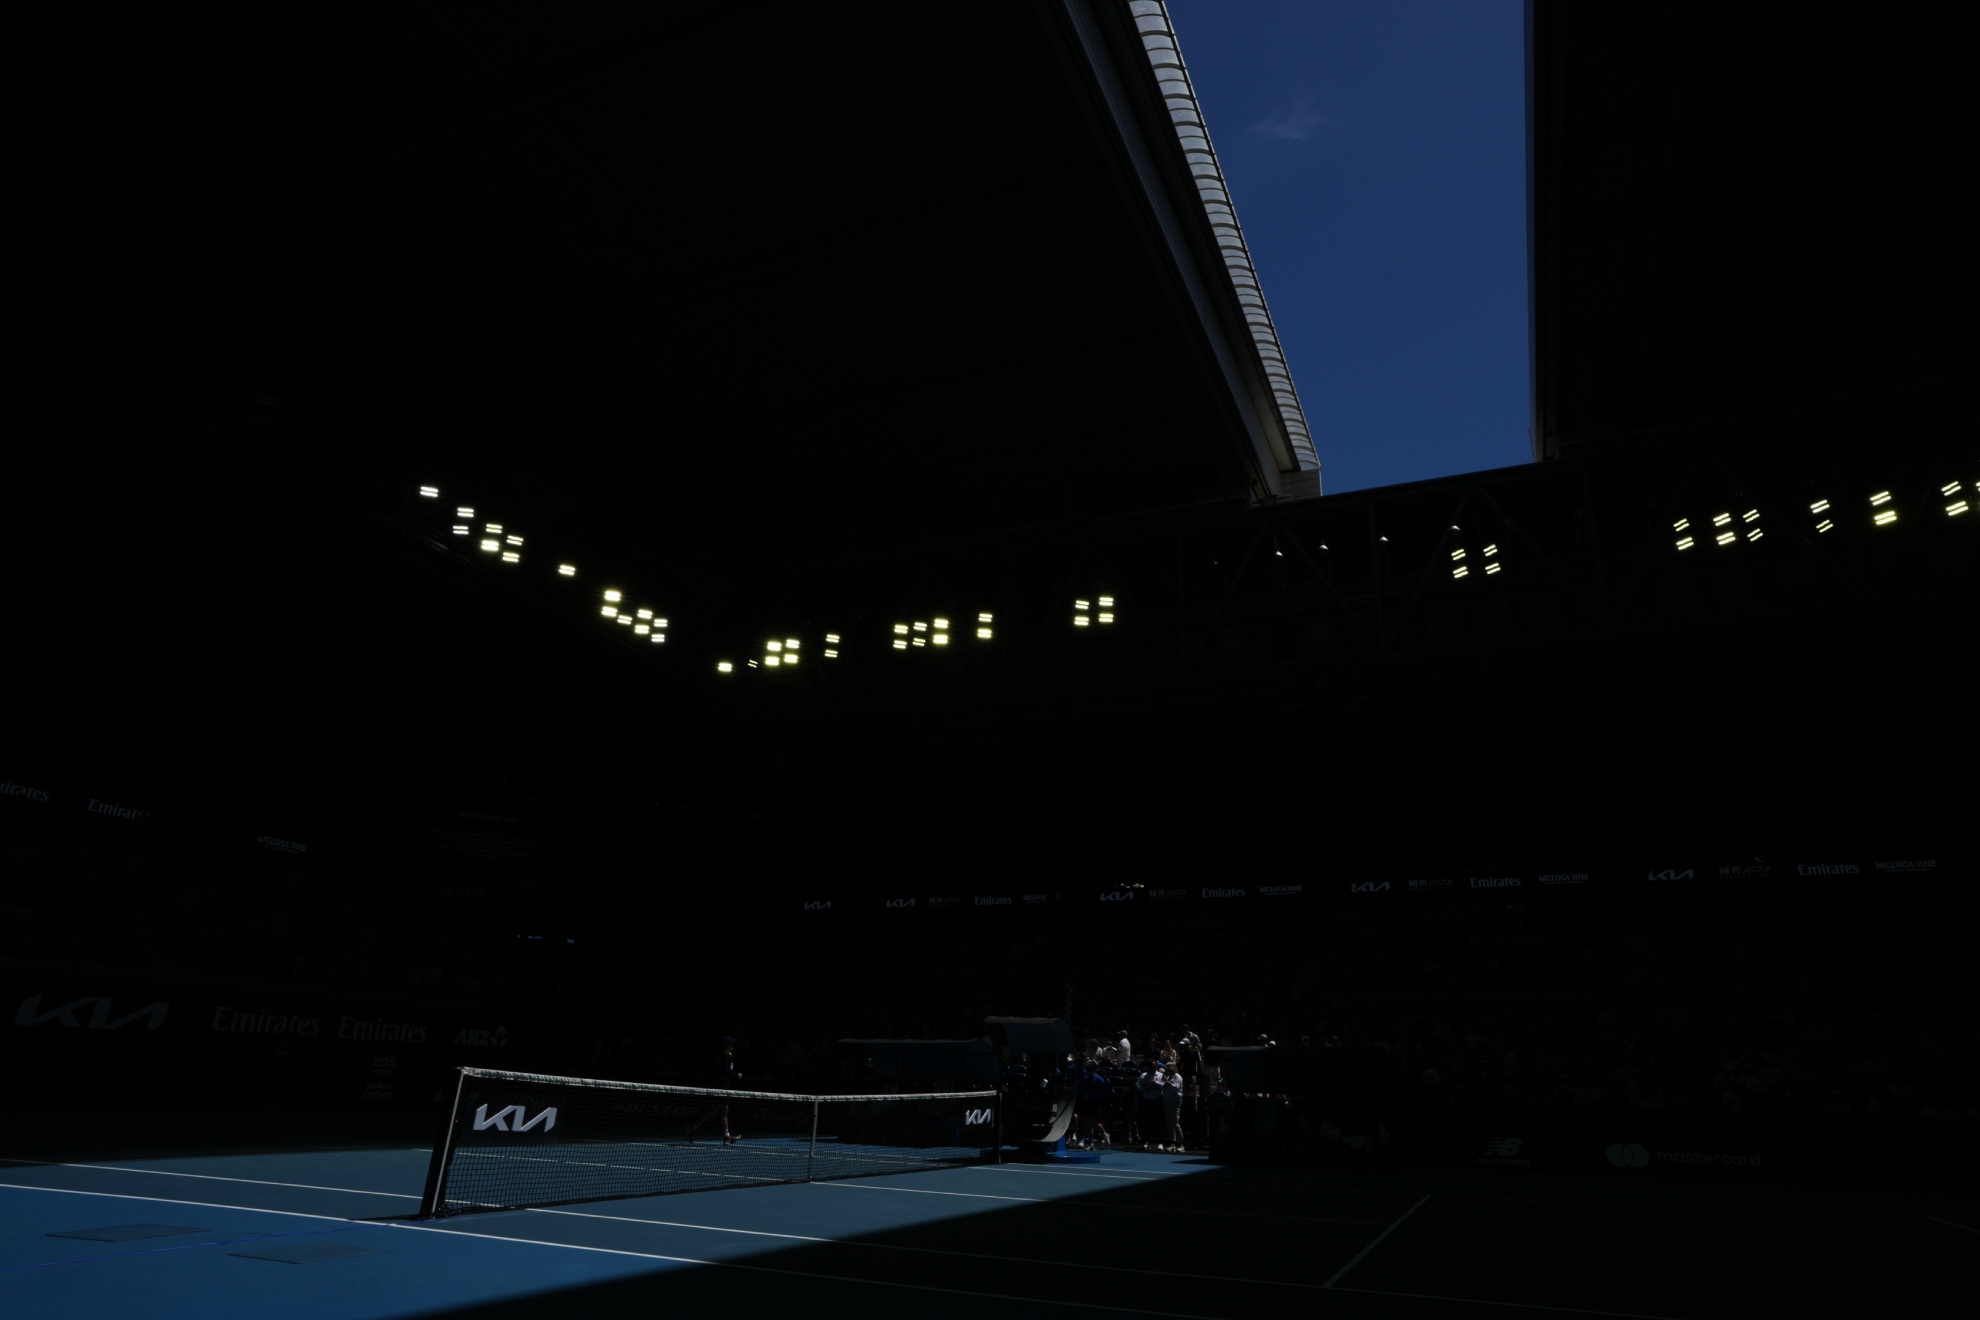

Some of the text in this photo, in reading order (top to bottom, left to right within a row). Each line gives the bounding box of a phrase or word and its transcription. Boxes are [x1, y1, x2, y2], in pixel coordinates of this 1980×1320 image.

[1797, 863, 1860, 876] Emirates
[1875, 859, 1937, 871] MELBOURNE
[1470, 876, 1522, 889] Emirates
[1538, 872, 1589, 883] MELBOURNE
[1201, 887, 1246, 899] Emirates
[974, 895, 1012, 907] Emirates
[14, 993, 170, 1031] KIA
[211, 1006, 321, 1036] Emirates
[337, 1015, 429, 1044] Emirates
[453, 1027, 493, 1047] ANZ
[372, 1056, 398, 1068] 205
[472, 1102, 558, 1133] KIA
[964, 1107, 992, 1126] KIA
[1495, 1157, 1531, 1166] balance
[1656, 1149, 1762, 1167] mastercard
